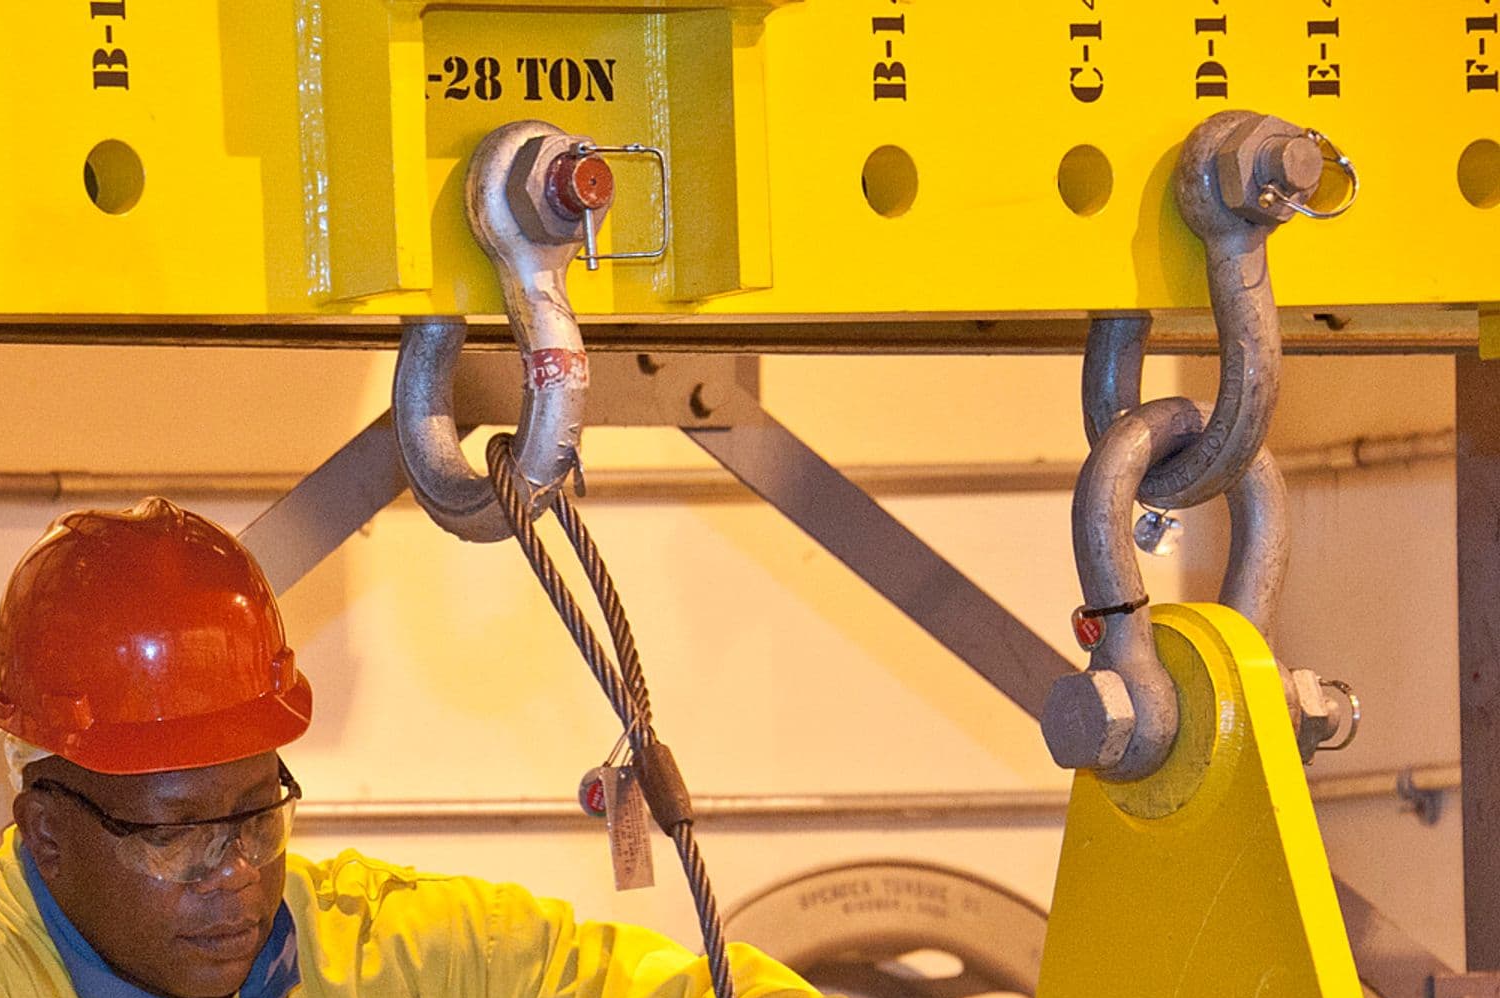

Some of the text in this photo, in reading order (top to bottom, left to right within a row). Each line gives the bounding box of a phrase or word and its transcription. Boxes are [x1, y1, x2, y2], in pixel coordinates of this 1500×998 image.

[516, 57, 617, 102] TON
[872, 0, 907, 102] B-1
[1195, 0, 1228, 100] D-1
[1466, 0, 1499, 93] F-1
